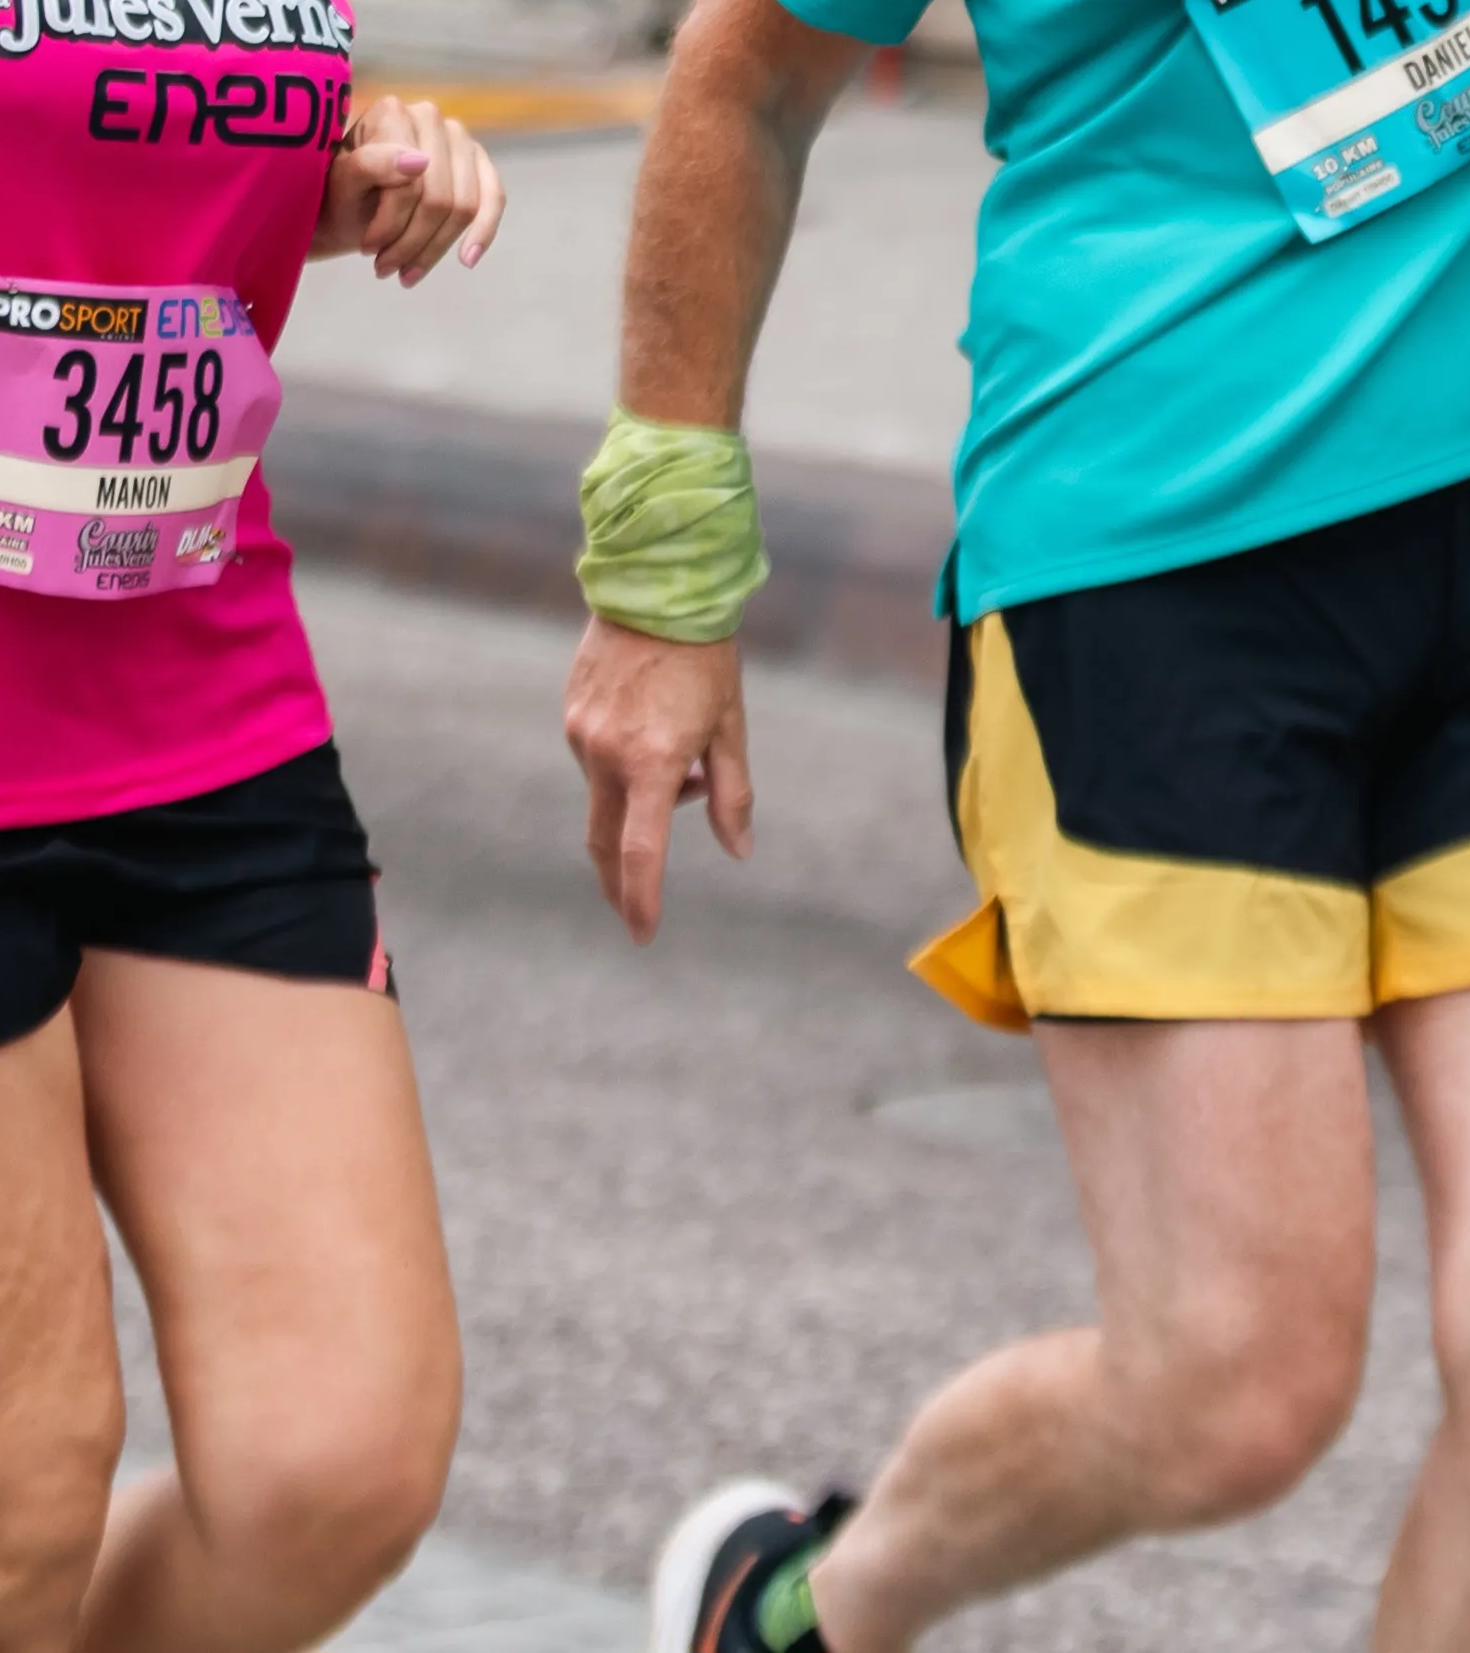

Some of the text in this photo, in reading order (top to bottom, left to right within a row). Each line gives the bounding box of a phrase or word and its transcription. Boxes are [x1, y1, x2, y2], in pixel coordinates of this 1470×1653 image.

[1312, 137, 1379, 181] 10 KM
[42, 349, 224, 464] 3458
[95, 475, 172, 510] MANON
